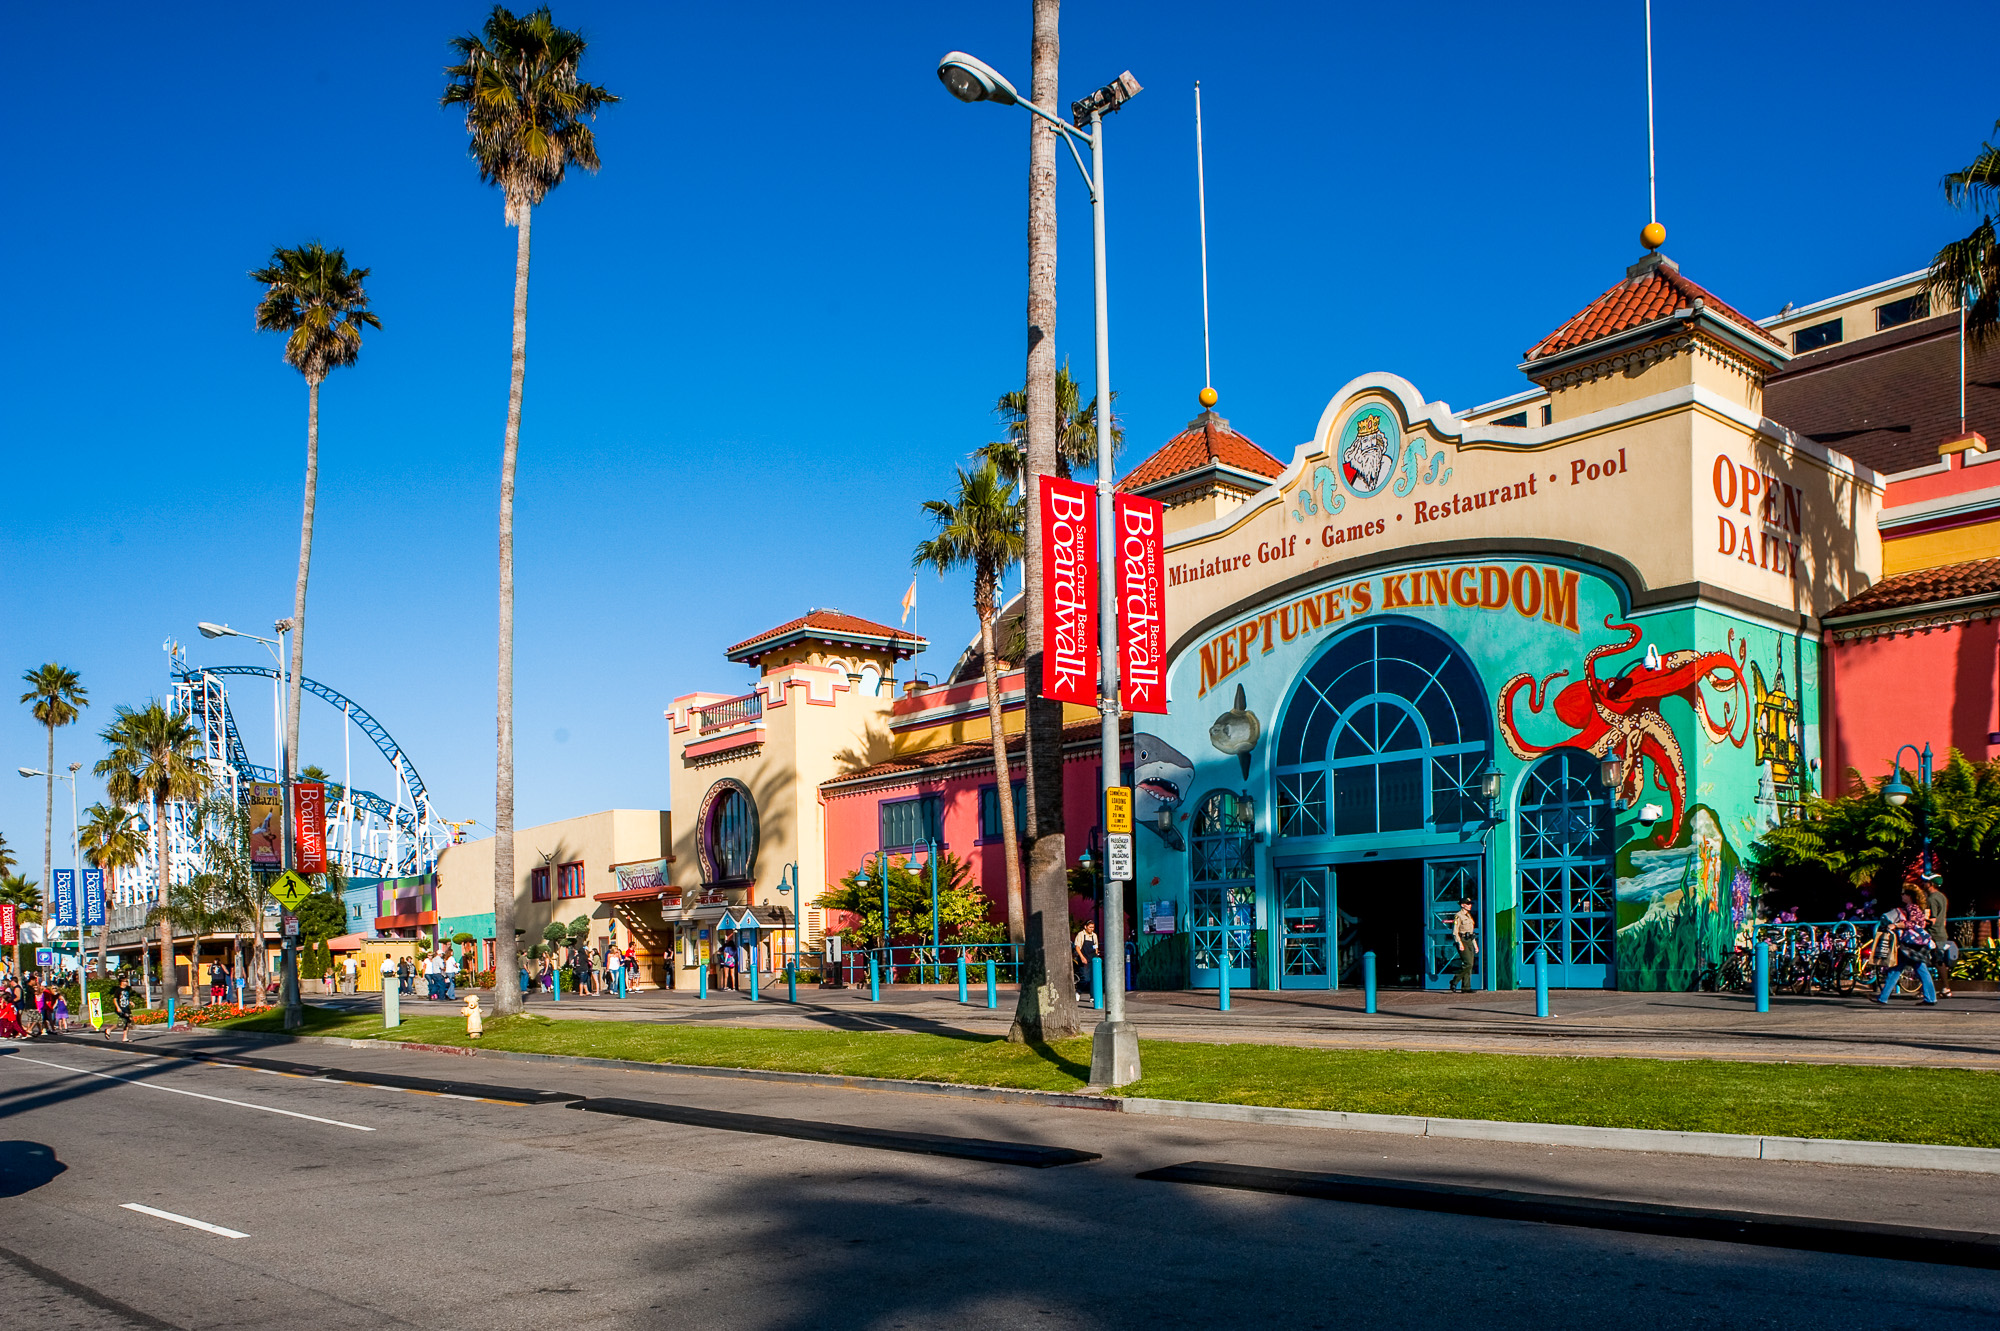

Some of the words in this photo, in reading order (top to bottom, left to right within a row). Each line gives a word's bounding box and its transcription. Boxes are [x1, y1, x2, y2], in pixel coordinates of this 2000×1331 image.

[1168, 553, 1251, 587] Miniature
[1257, 535, 1297, 564] Golf
[1321, 518, 1385, 548] Games
[1414, 473, 1538, 525] Restaurant
[1570, 447, 1627, 486] Pool
[1712, 453, 1803, 537] OPEN
[1077, 525, 1086, 562] Santa
[1146, 538, 1155, 574] Santa
[1717, 515, 1801, 580] DAILY
[1051, 486, 1086, 694] Boardwalk
[1077, 564, 1088, 598] Cruz
[1123, 503, 1158, 704] Boardwalk
[1147, 576, 1158, 609] Cruz
[1078, 613, 1088, 653] Beach
[1150, 624, 1160, 663] Beach
[1197, 581, 1373, 700] NEPTUNE'S
[1381, 564, 1581, 635] KINGDOM
[254, 785, 278, 797] CIRCO
[300, 787, 321, 870] Boardwalk
[57, 871, 72, 924] Boardwalk
[86, 871, 102, 924] Boardwalk
[619, 866, 666, 891] Boardwalk
[2, 905, 15, 944] Boardwalk
